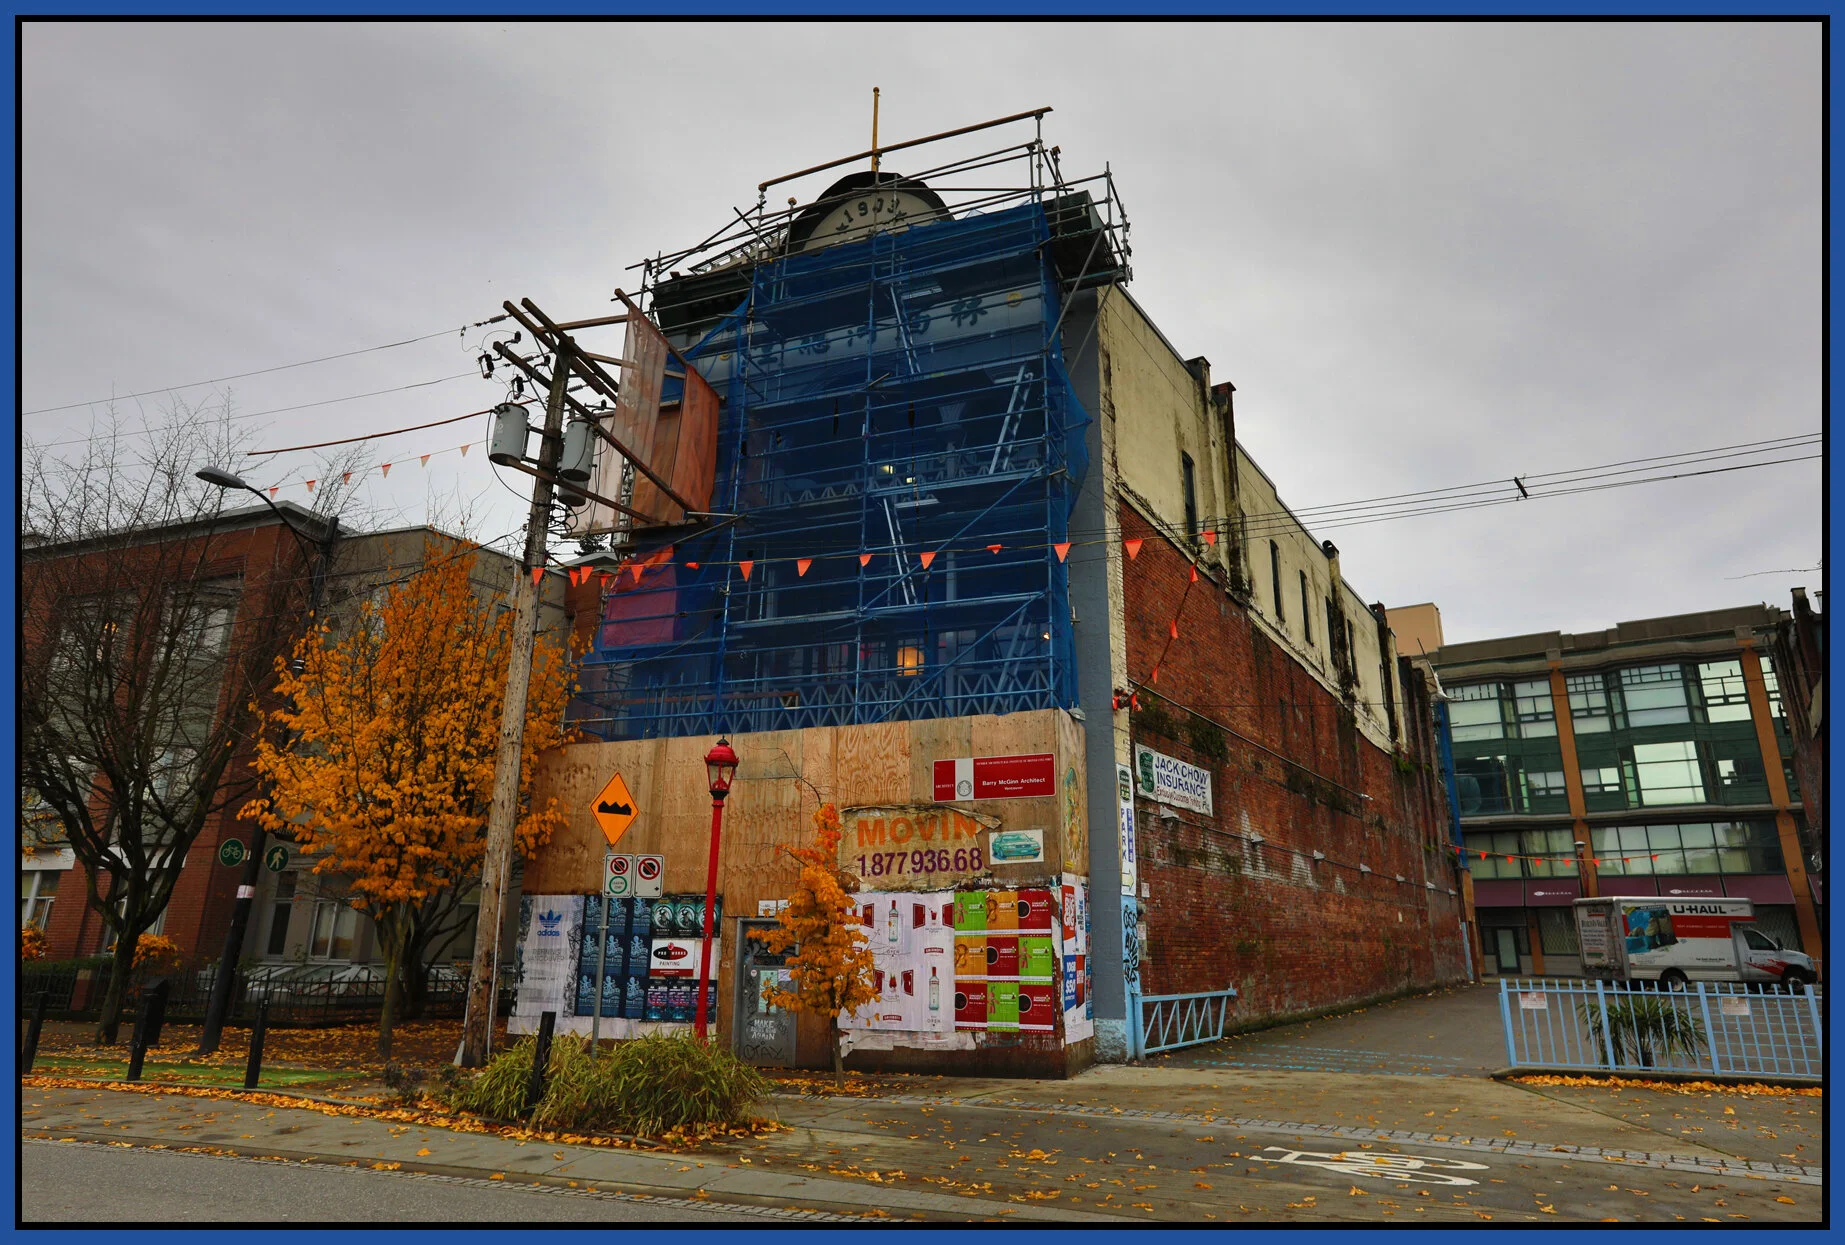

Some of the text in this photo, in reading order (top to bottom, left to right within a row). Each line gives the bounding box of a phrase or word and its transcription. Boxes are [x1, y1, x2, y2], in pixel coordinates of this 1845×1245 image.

[844, 198, 900, 223] 1903
[1155, 757, 1180, 775] JACK
[1181, 765, 1208, 785] CHOW
[857, 811, 986, 848] MOVIN
[1673, 904, 1727, 914] U-HAUL
[537, 929, 560, 937] adidas
[754, 1019, 775, 1027] MAKE
